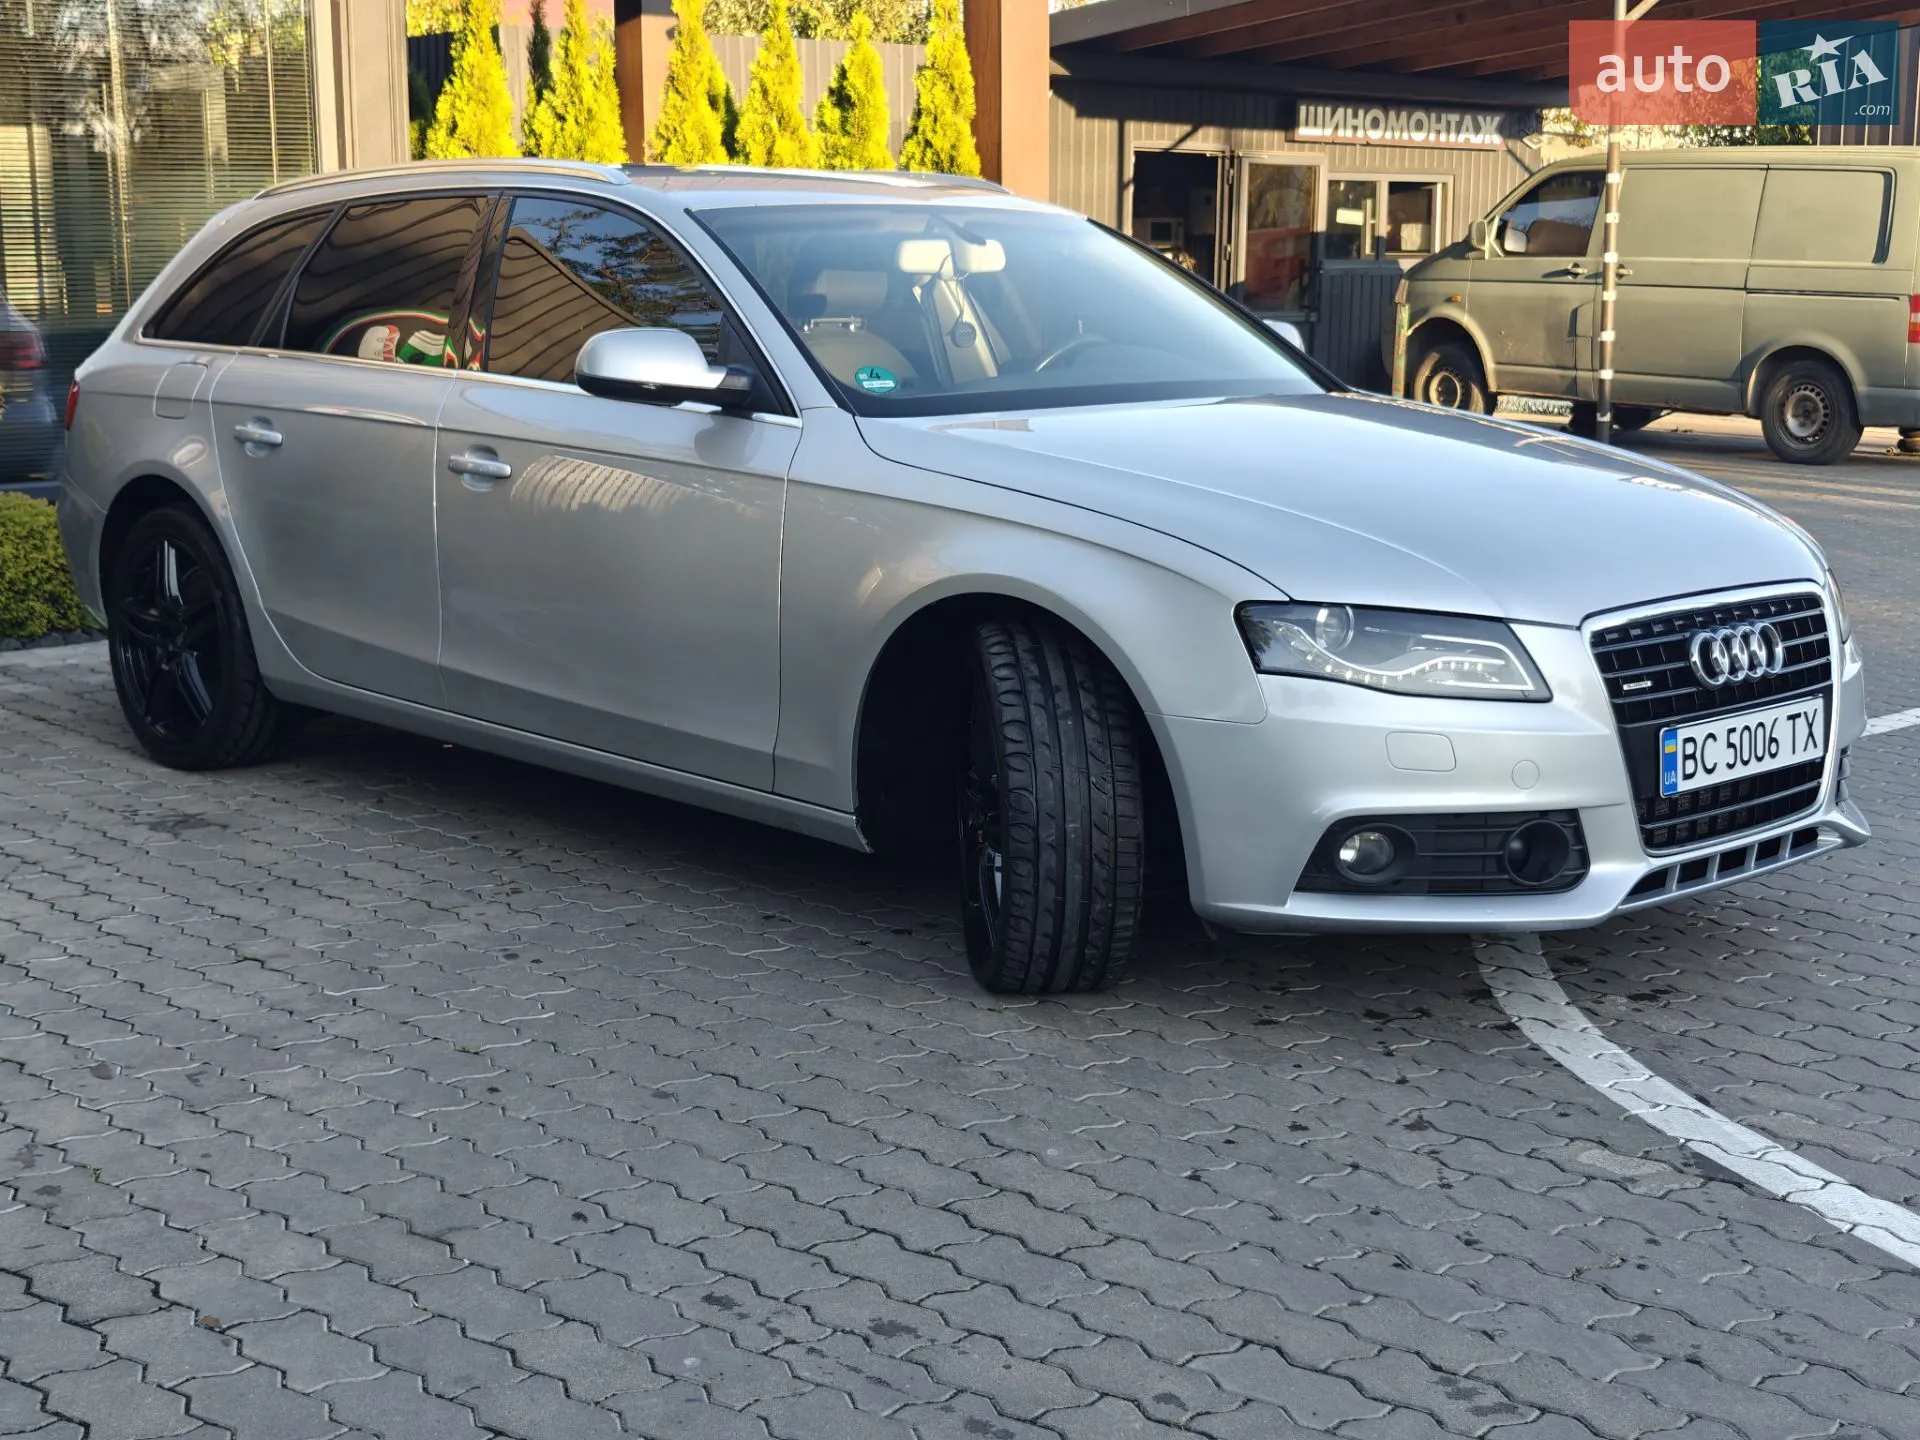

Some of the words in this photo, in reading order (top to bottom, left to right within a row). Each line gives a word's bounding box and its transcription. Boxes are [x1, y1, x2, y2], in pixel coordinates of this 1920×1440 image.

[1298, 104, 1501, 144] ШИНОМОНТАЖ
[1682, 732, 1718, 781] BC
[1725, 717, 1780, 770] 5006
[1786, 707, 1819, 755] TX
[1664, 770, 1677, 786] UA
